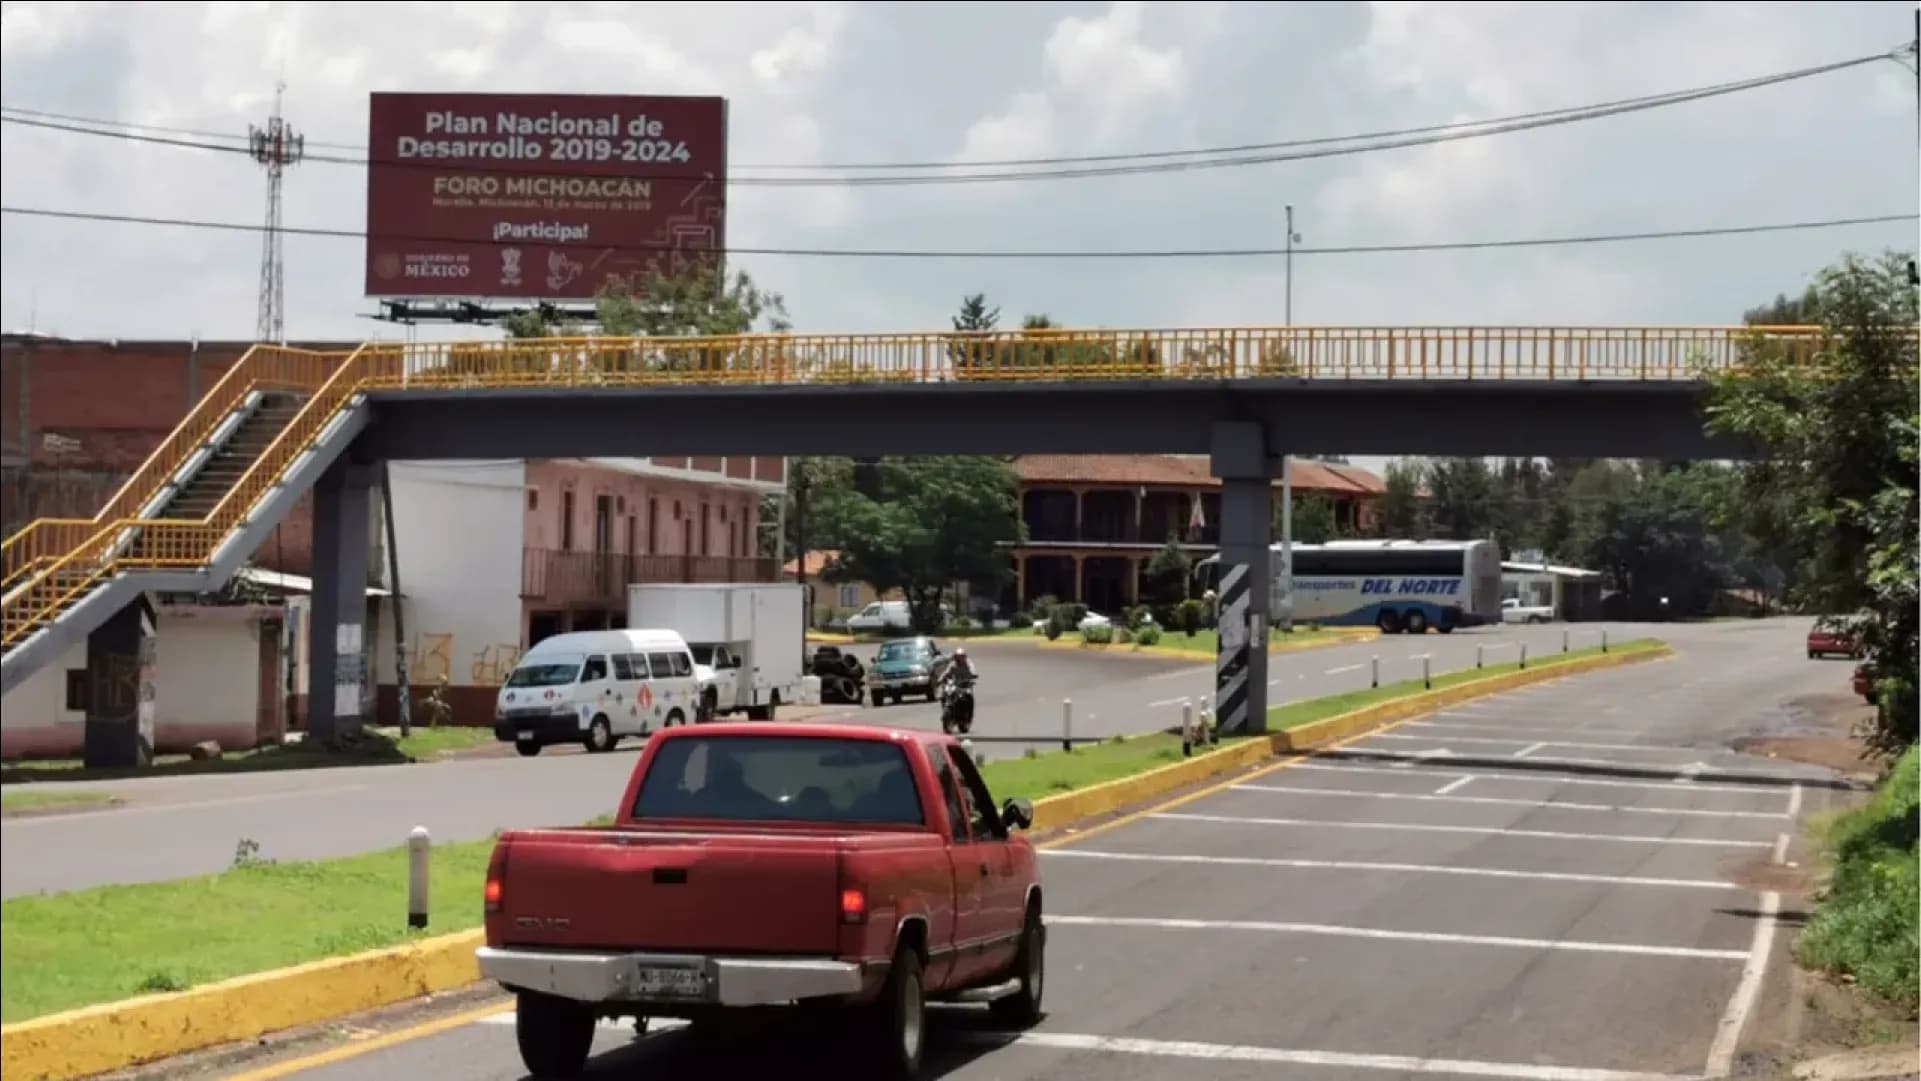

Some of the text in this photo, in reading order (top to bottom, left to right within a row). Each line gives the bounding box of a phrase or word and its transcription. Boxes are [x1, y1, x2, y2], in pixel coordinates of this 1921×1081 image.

[426, 112, 664, 137] Plan Nacional de
[398, 137, 691, 163] Desarrollo 2019-2024
[433, 176, 652, 197] FORO MICHOACÁN
[493, 220, 590, 242] ¡Participa!
[405, 261, 471, 278] MÉXICO
[1360, 578, 1392, 595] DEL
[1398, 579, 1462, 595] NORTE
